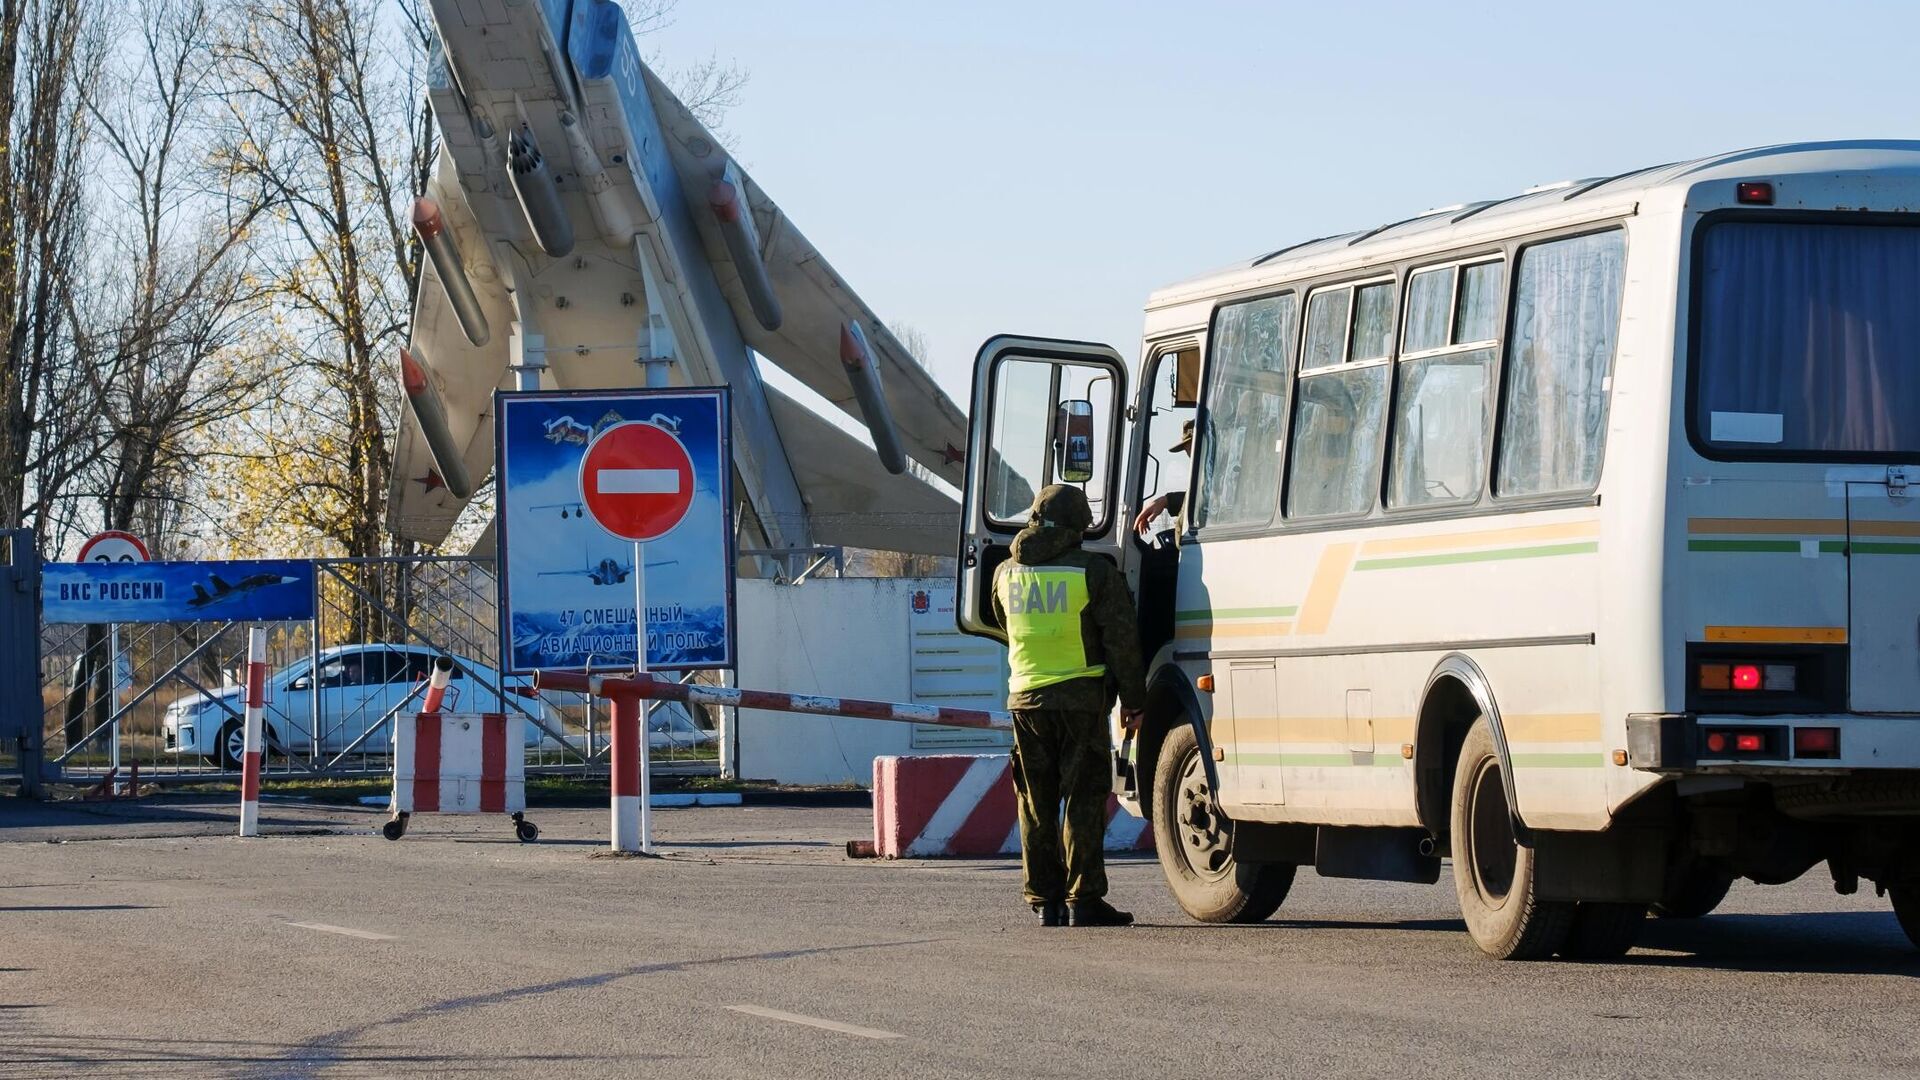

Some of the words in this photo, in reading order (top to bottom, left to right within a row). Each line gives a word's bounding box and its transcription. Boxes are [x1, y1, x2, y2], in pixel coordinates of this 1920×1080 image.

[60, 582, 91, 601] ВКС
[101, 581, 164, 600] РОССИИ
[1008, 580, 1068, 614] ВАИ
[559, 610, 575, 625] 47
[540, 631, 657, 654] АВИАЦИОННЙ
[665, 630, 706, 650] ПОЛК
